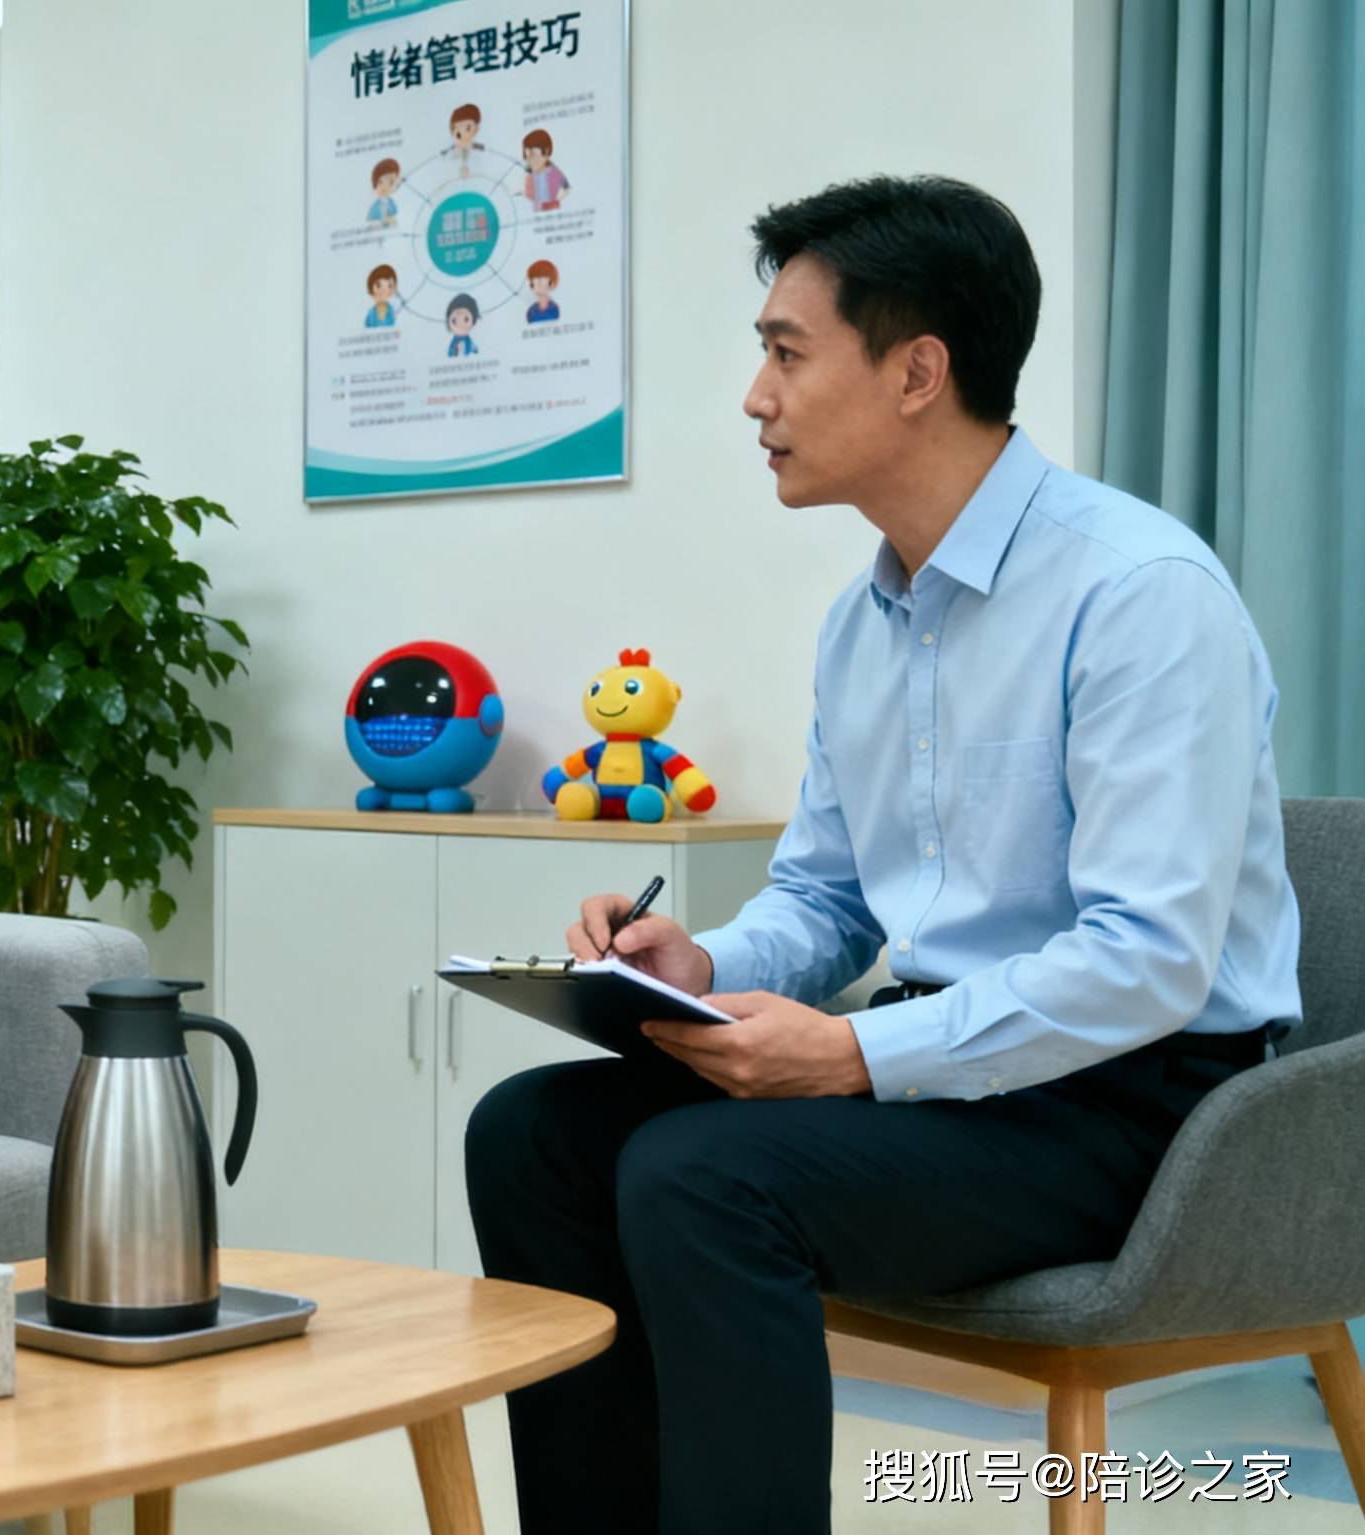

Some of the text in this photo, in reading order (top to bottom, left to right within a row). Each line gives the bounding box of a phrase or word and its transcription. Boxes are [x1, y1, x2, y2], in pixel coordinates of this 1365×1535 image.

[351, 11, 582, 98] 情绪管理技巧
